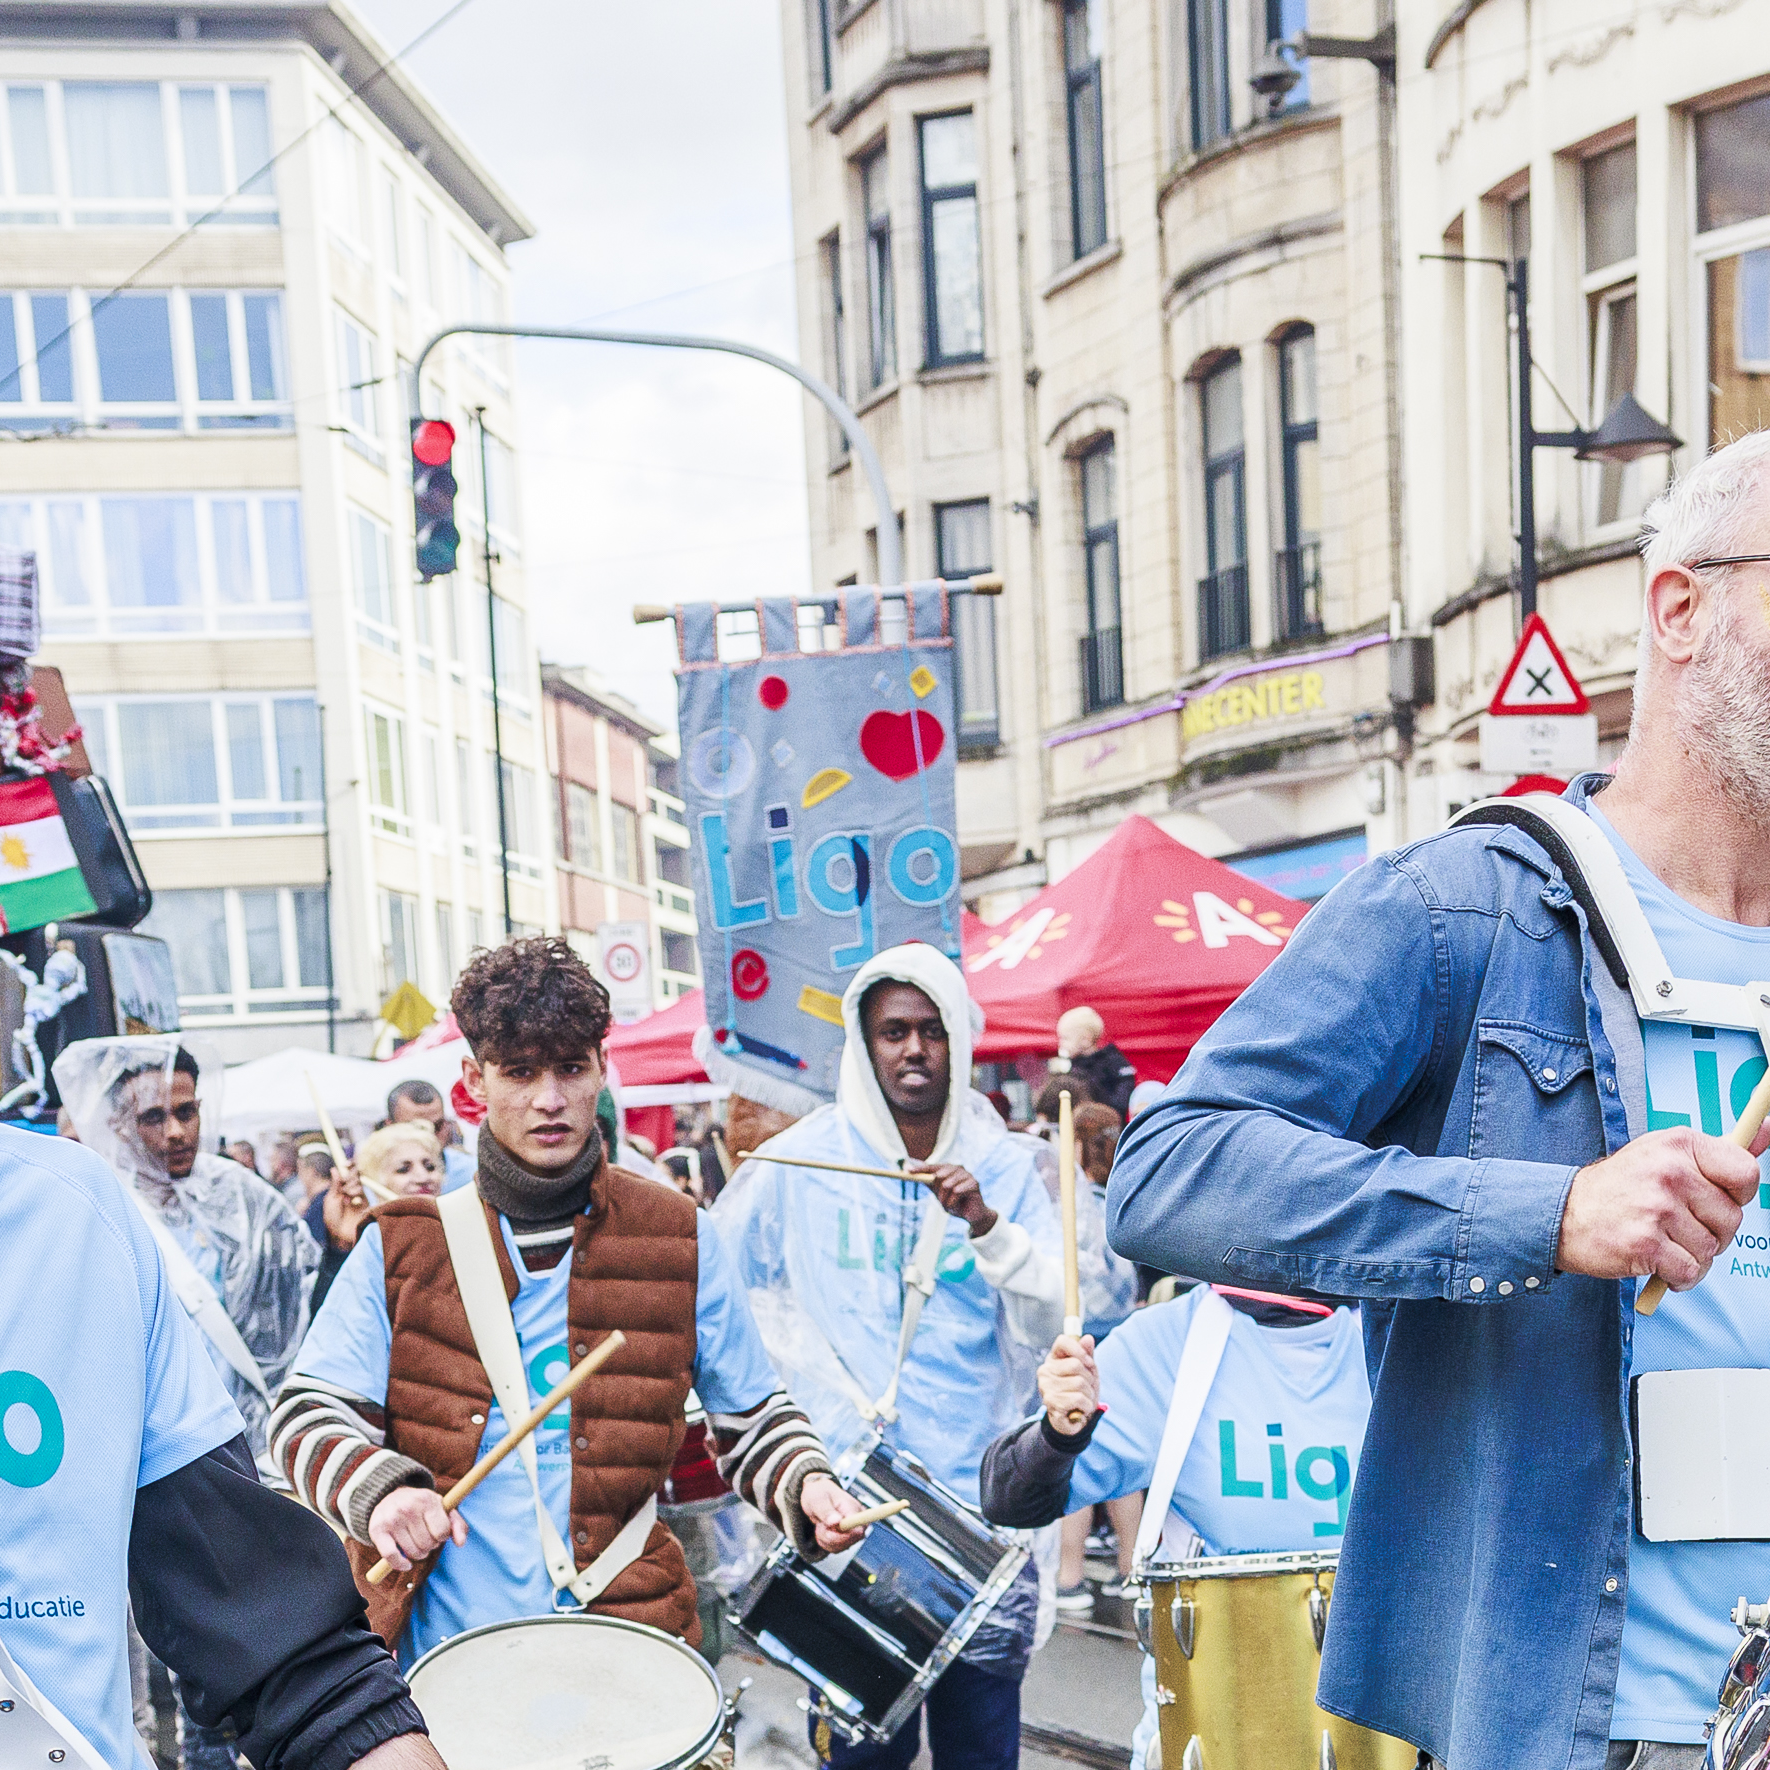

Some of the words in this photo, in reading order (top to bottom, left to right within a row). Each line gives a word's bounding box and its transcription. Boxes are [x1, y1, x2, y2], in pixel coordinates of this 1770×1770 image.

[698, 803, 961, 973] Ligo
[837, 1208, 976, 1284] Lio
[1218, 1419, 1353, 1538] Lig
